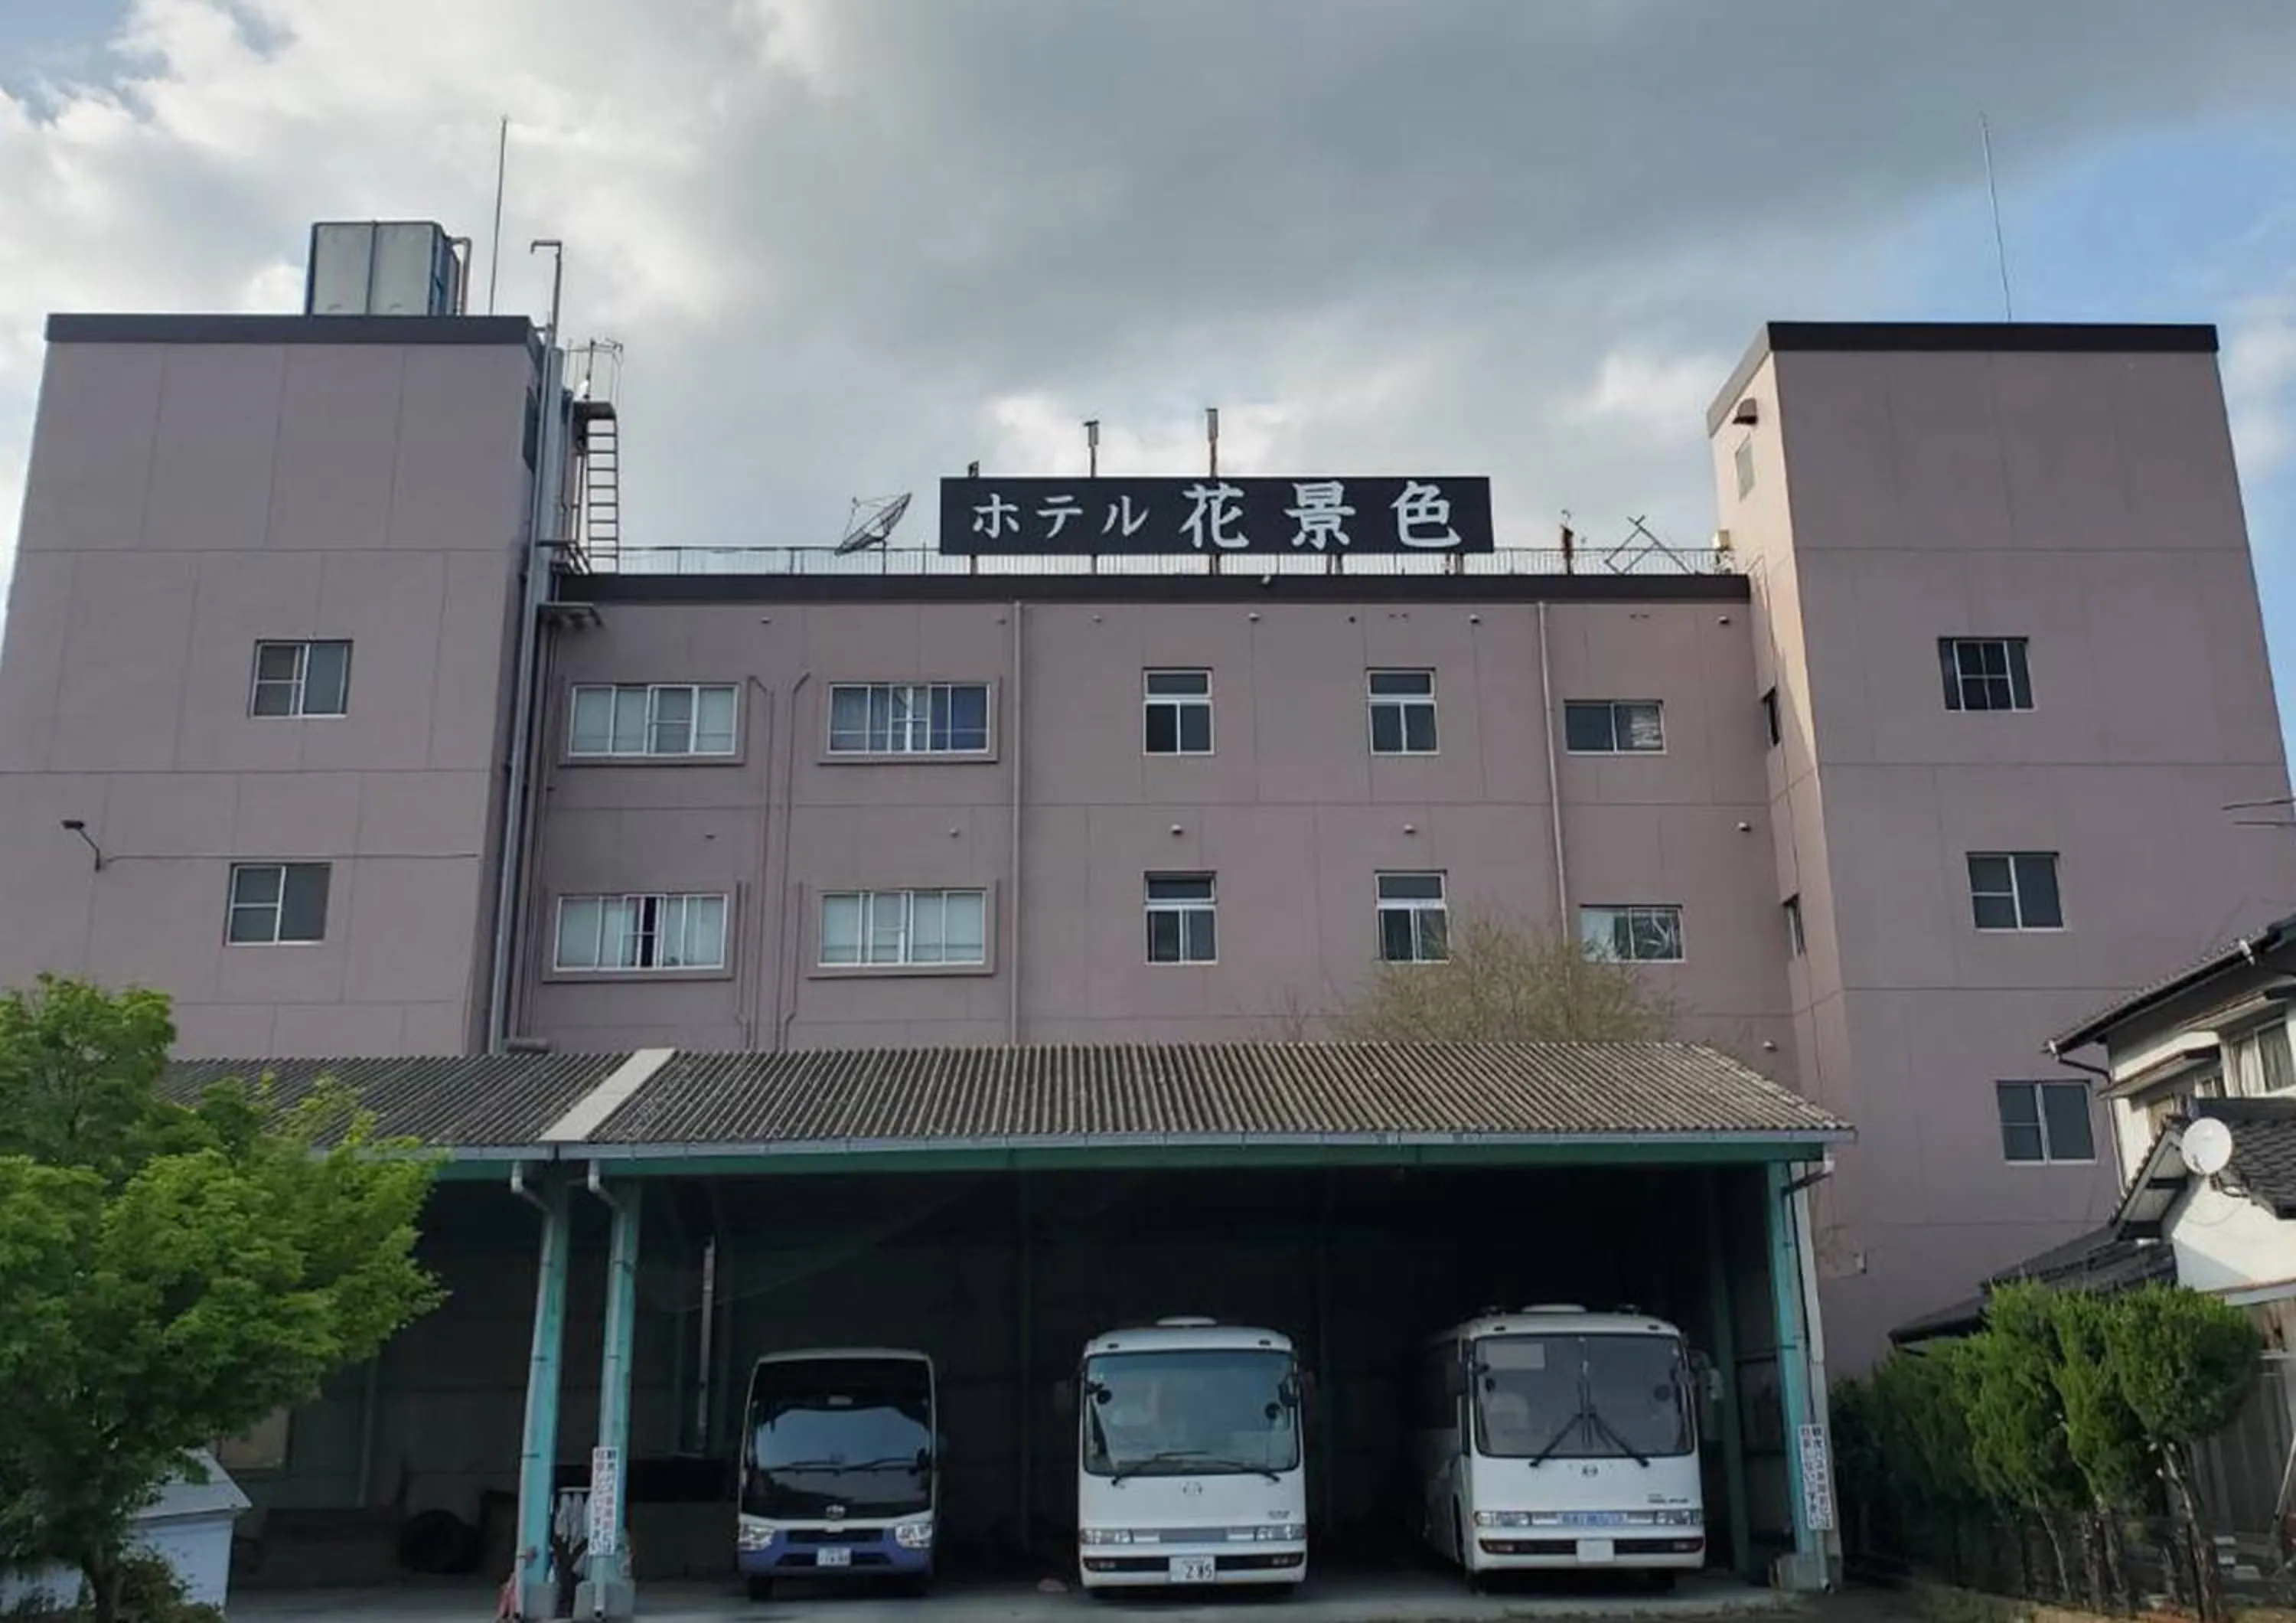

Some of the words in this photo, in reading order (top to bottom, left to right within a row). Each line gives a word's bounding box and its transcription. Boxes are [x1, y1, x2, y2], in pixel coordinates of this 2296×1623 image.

[972, 479, 1461, 550] ホテル花景色
